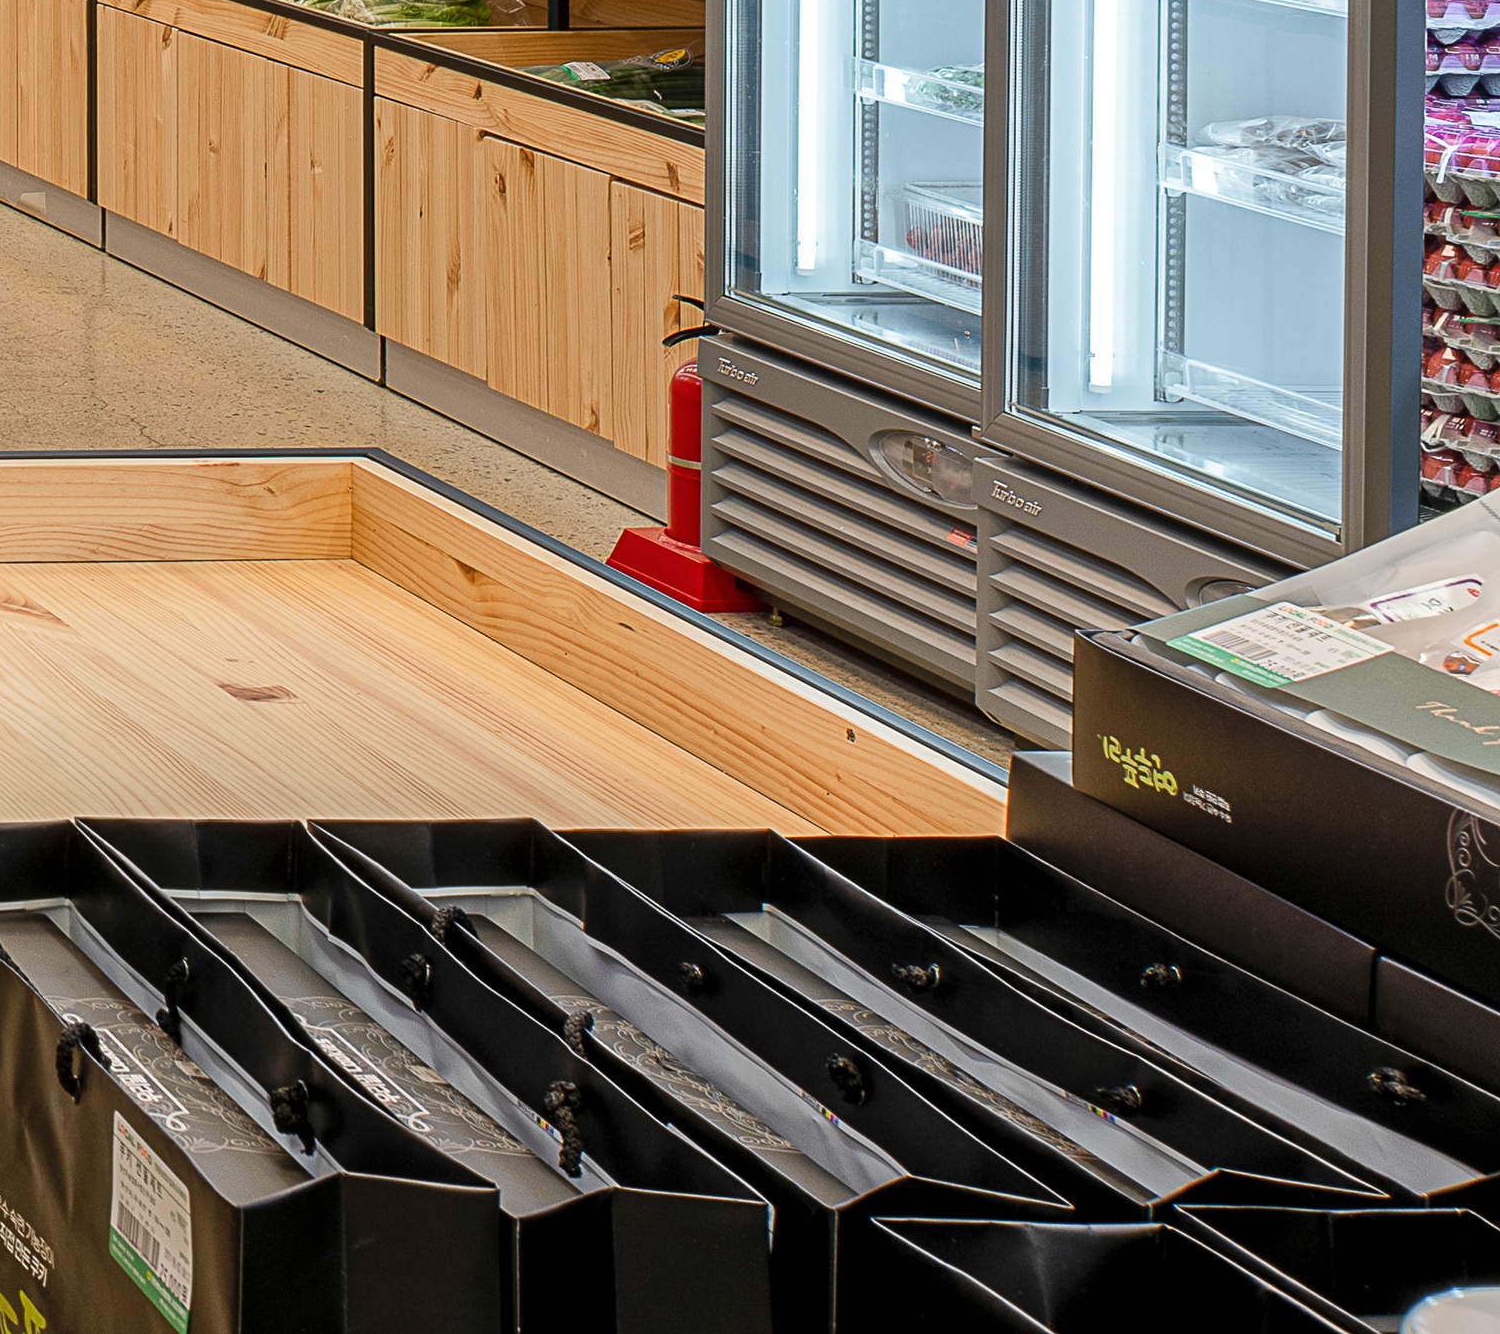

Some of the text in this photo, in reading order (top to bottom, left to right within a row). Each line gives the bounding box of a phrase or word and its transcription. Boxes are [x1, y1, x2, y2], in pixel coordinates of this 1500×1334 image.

[717, 357, 759, 385] Turbo air
[993, 479, 1043, 516] Turbo air
[118, 1123, 137, 1148] LOCAL
[0, 1221, 47, 1288] 직접 만든 쿠키
